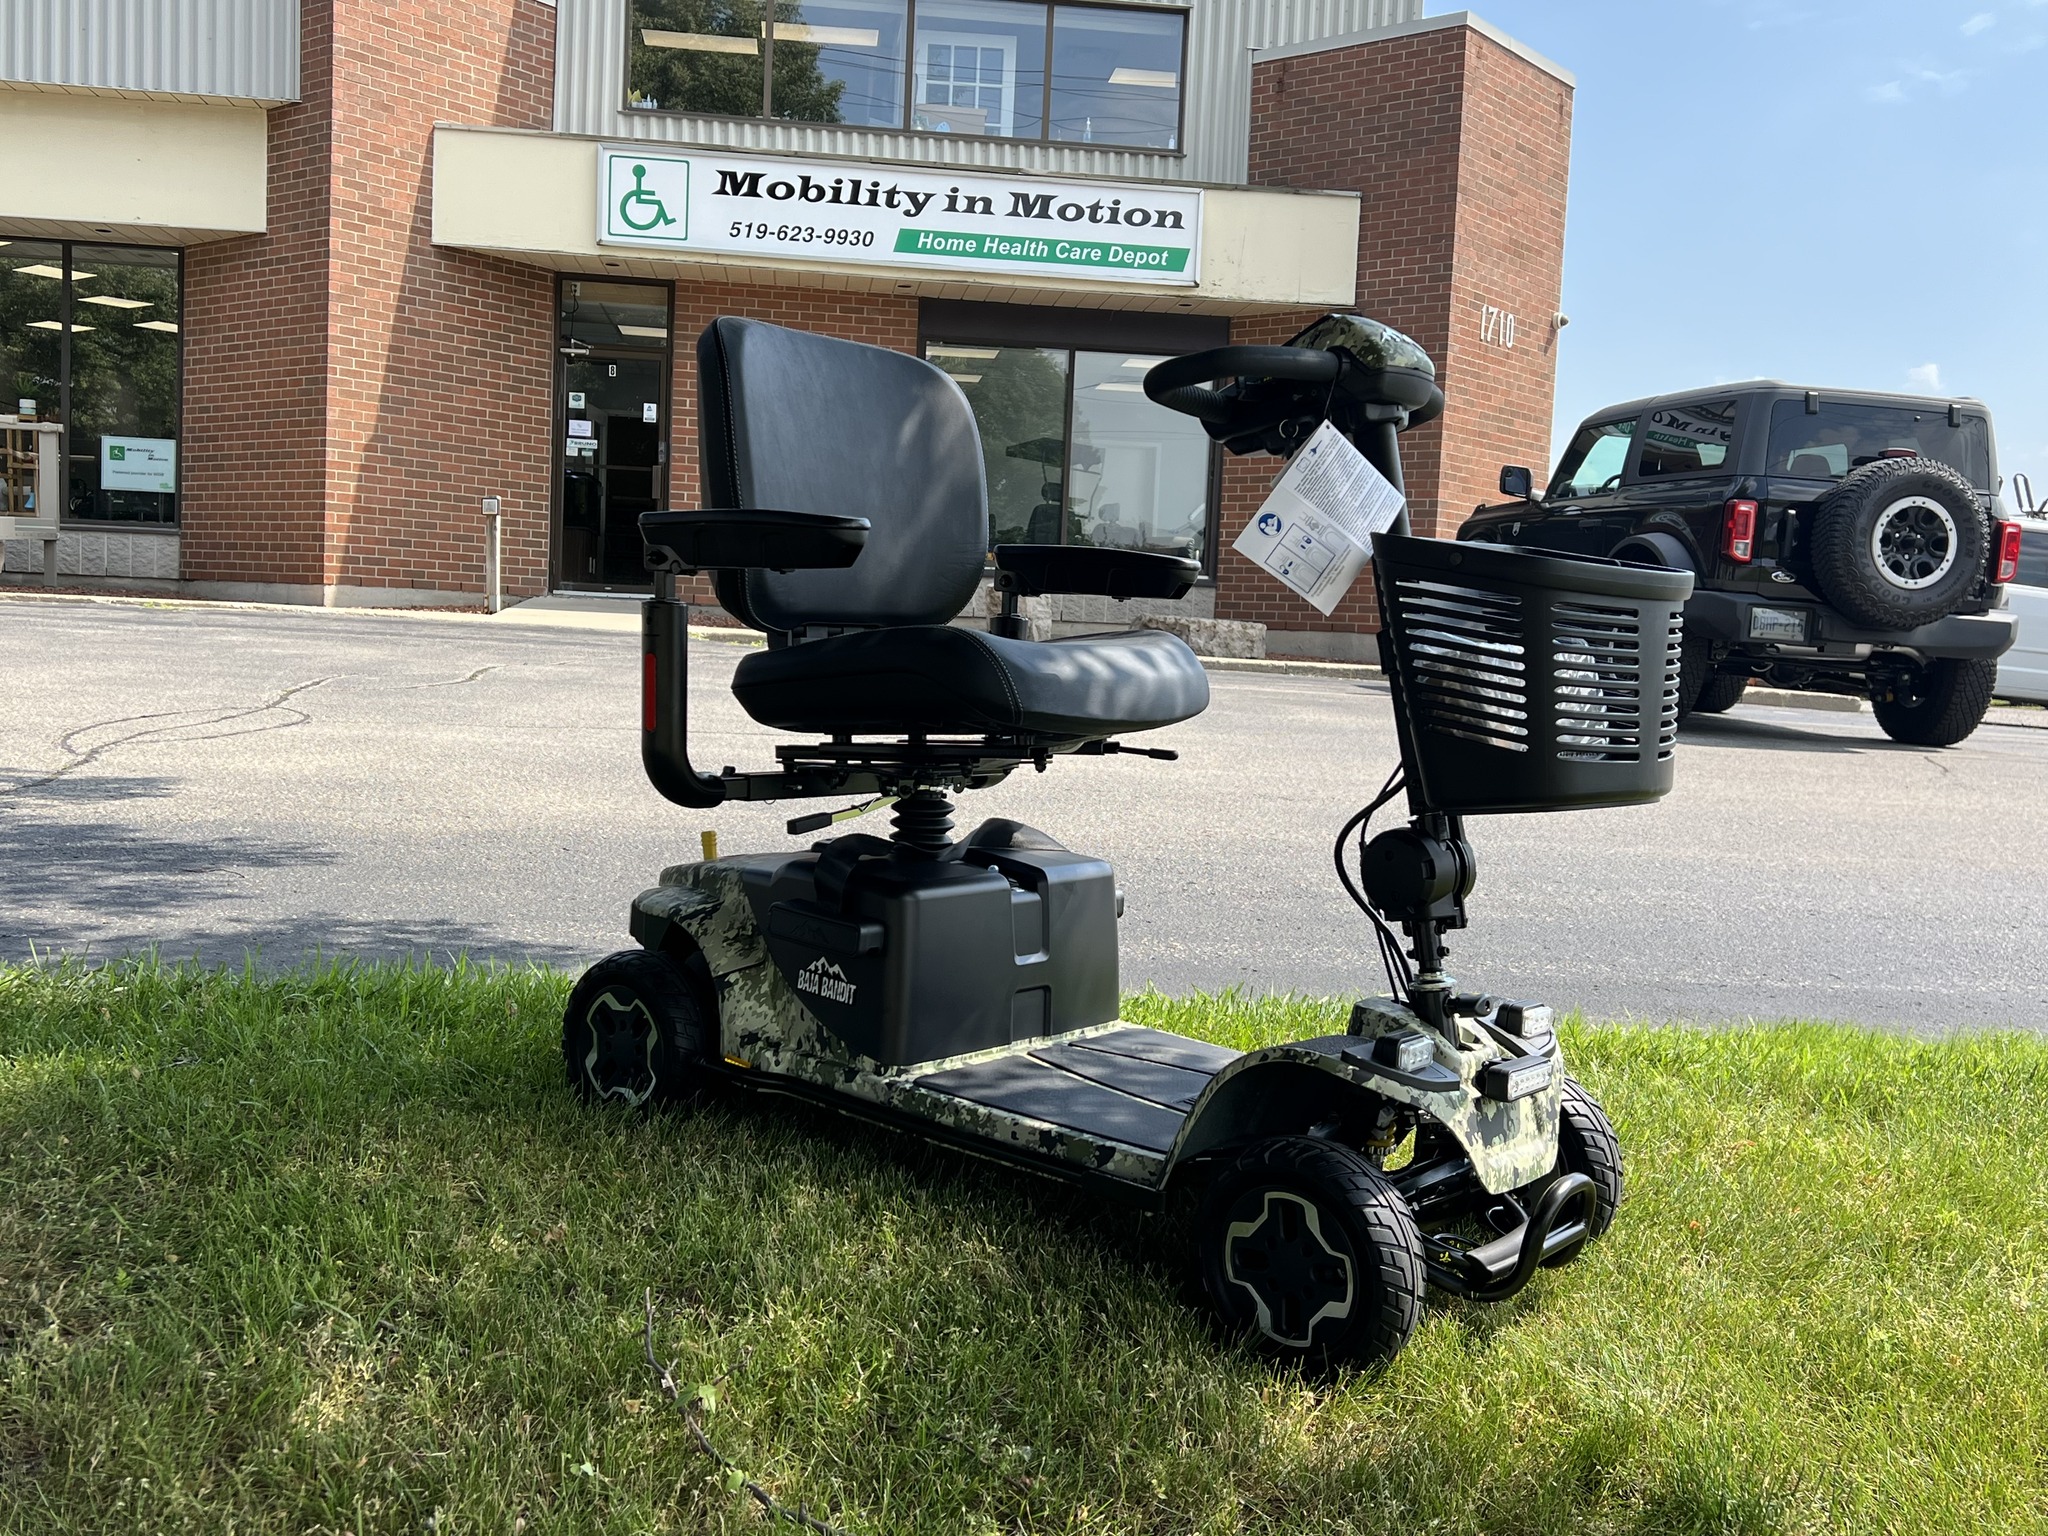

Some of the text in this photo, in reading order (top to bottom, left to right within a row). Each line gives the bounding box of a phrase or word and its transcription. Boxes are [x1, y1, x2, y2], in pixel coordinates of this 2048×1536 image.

[712, 169, 1186, 230] Mobility in Motion
[729, 221, 875, 248] 519-623-9930
[917, 231, 1170, 268] Home Health Care Depot
[1480, 304, 1514, 349] 1710
[610, 366, 615, 375] 8
[797, 969, 857, 1005] BAJA BANDIT
